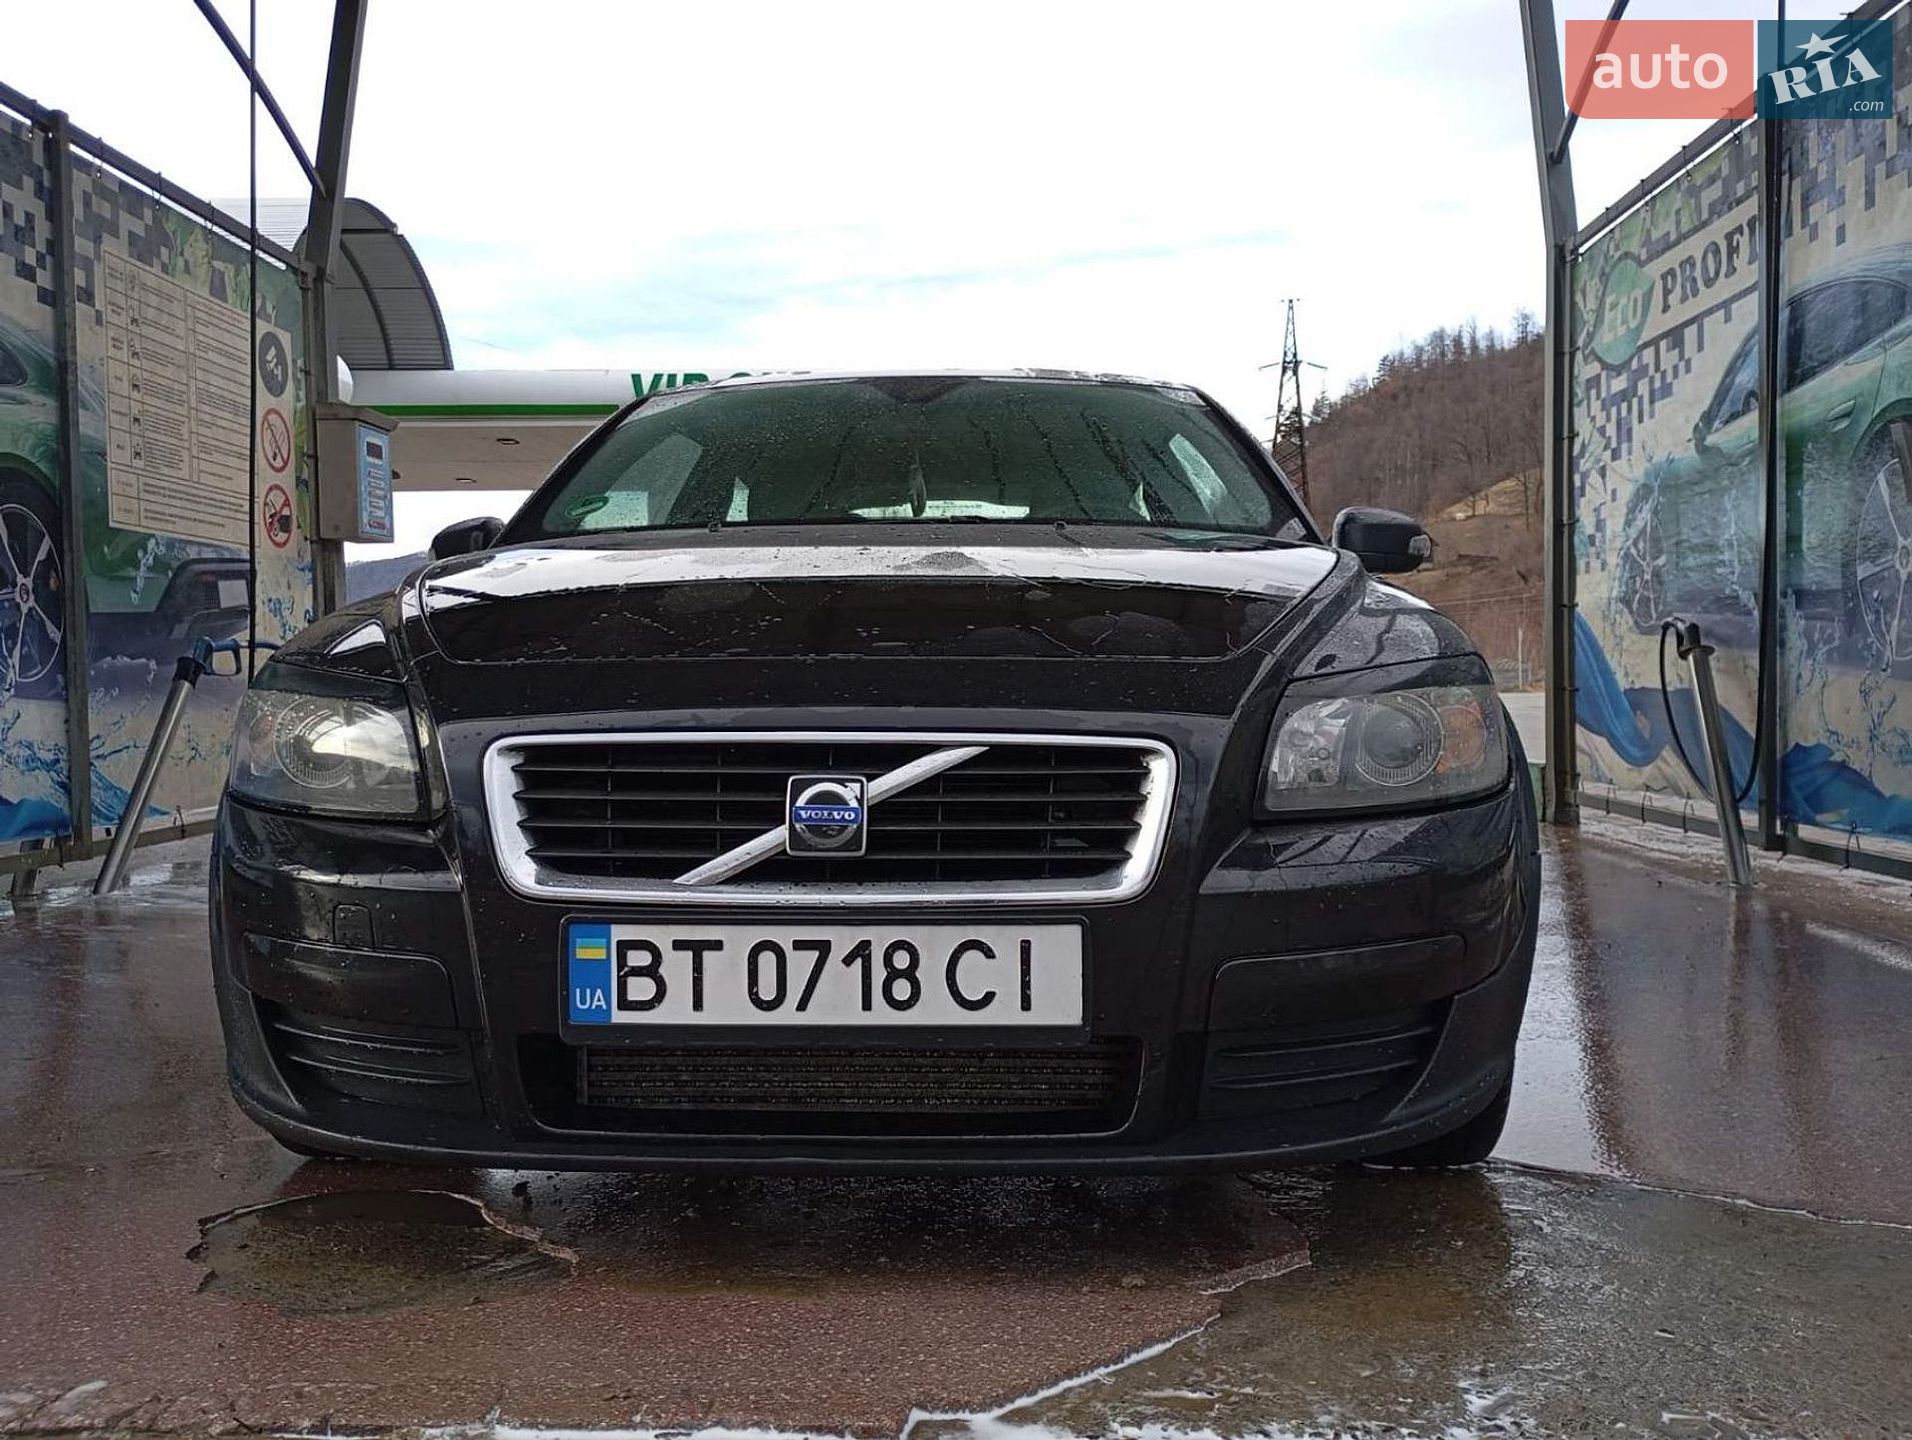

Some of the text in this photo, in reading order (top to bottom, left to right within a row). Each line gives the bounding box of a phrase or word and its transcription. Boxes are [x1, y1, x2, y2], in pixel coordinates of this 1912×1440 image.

[799, 809, 856, 821] VOLVO
[616, 938, 1032, 1012] BT 0718 CI
[575, 988, 607, 1010] UA
